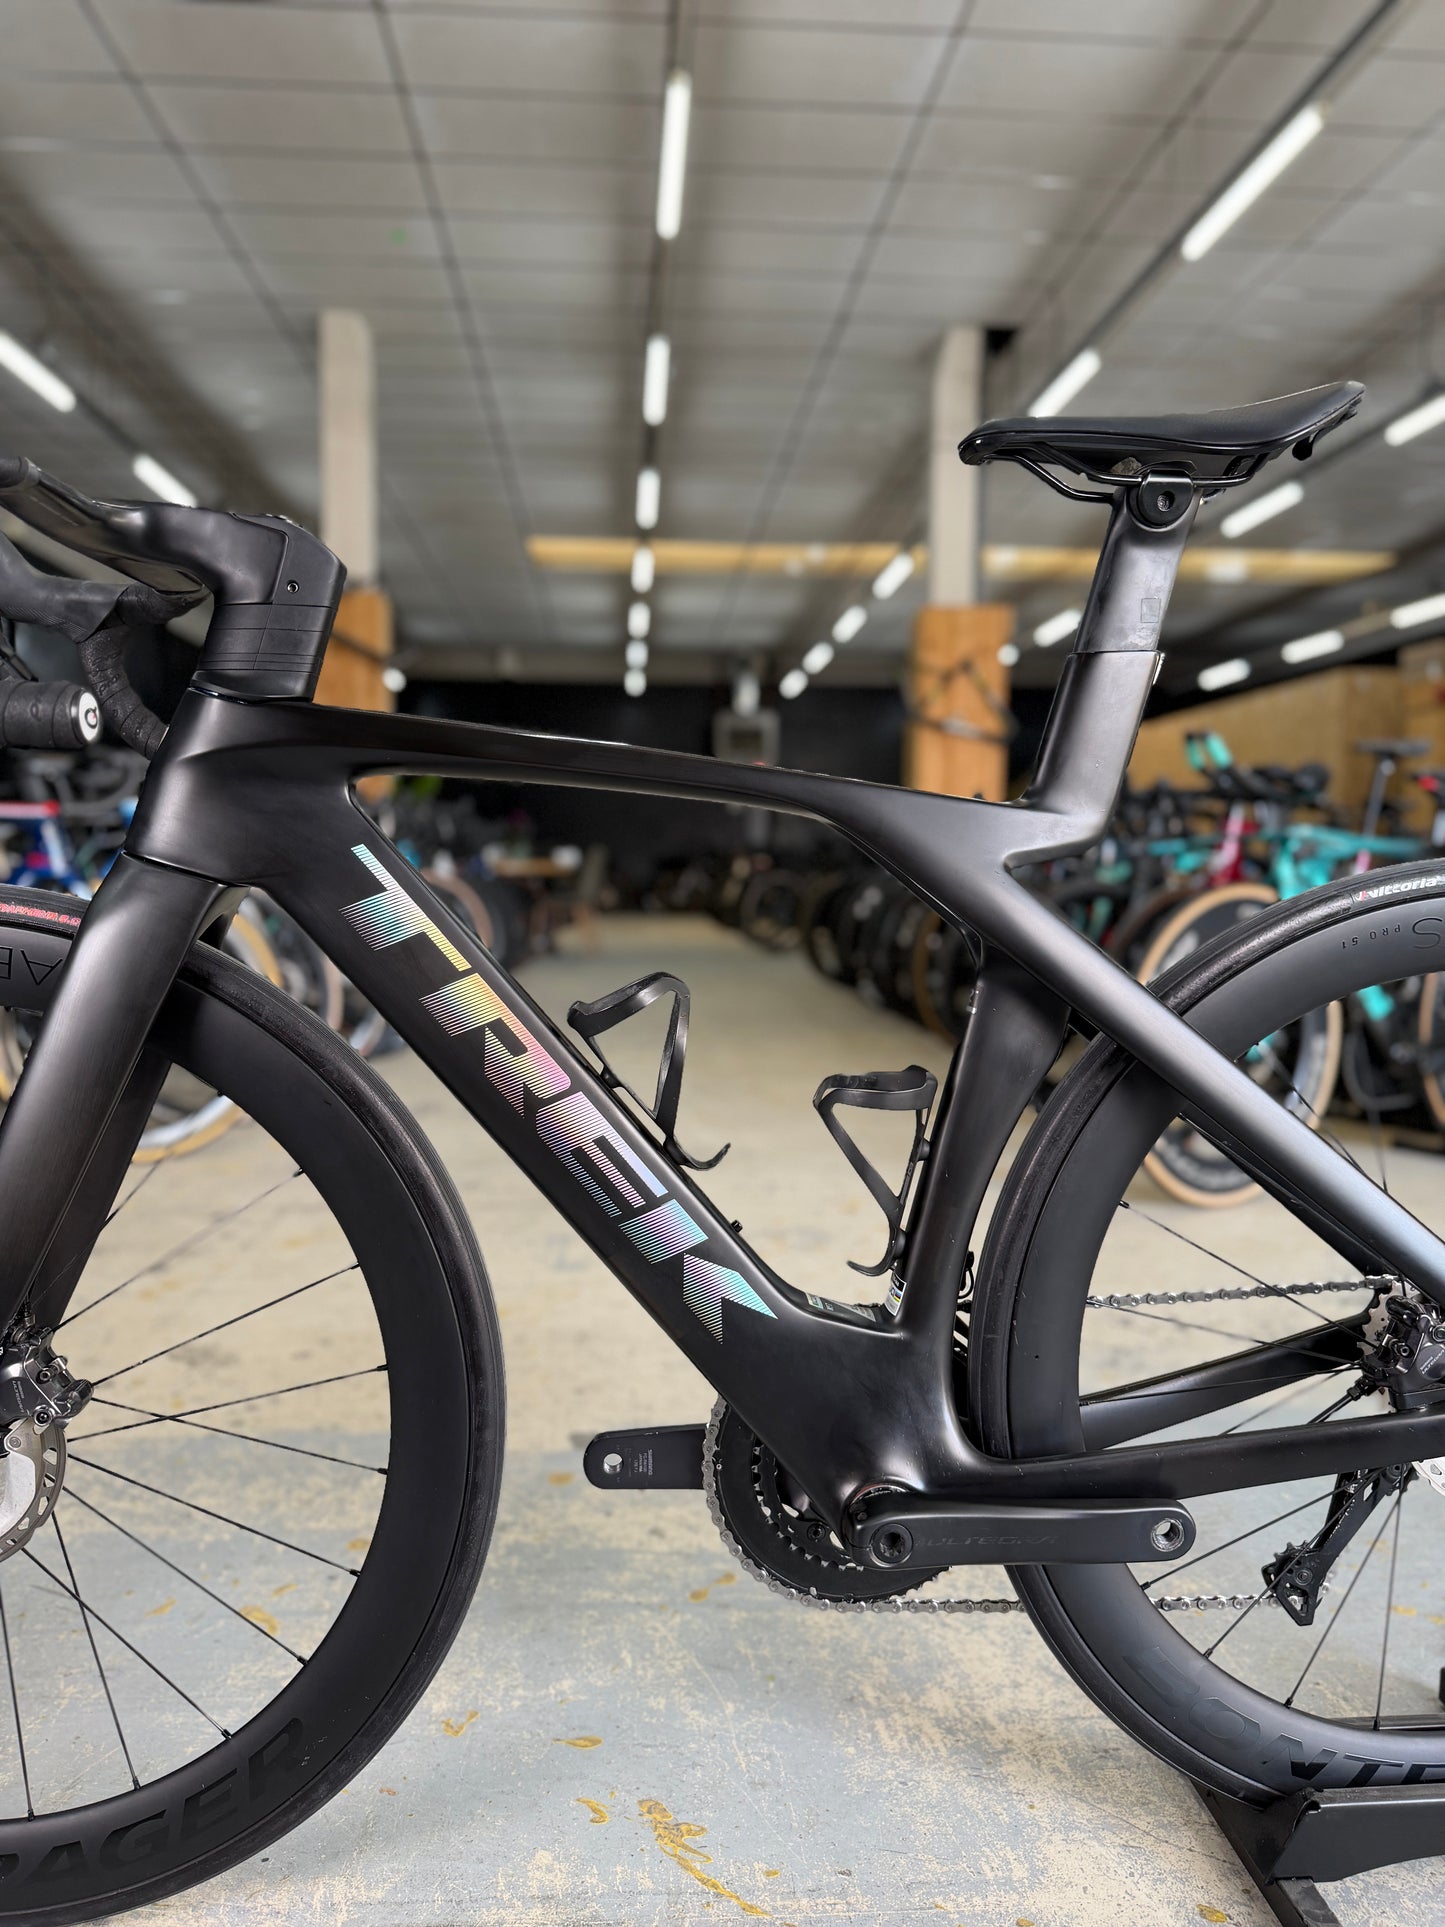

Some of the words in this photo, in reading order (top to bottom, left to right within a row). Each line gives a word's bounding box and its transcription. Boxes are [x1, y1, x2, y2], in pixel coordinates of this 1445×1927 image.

[1369, 924, 1401, 940] PRO
[1342, 936, 1359, 950] 51
[339, 844, 778, 1344] TREK
